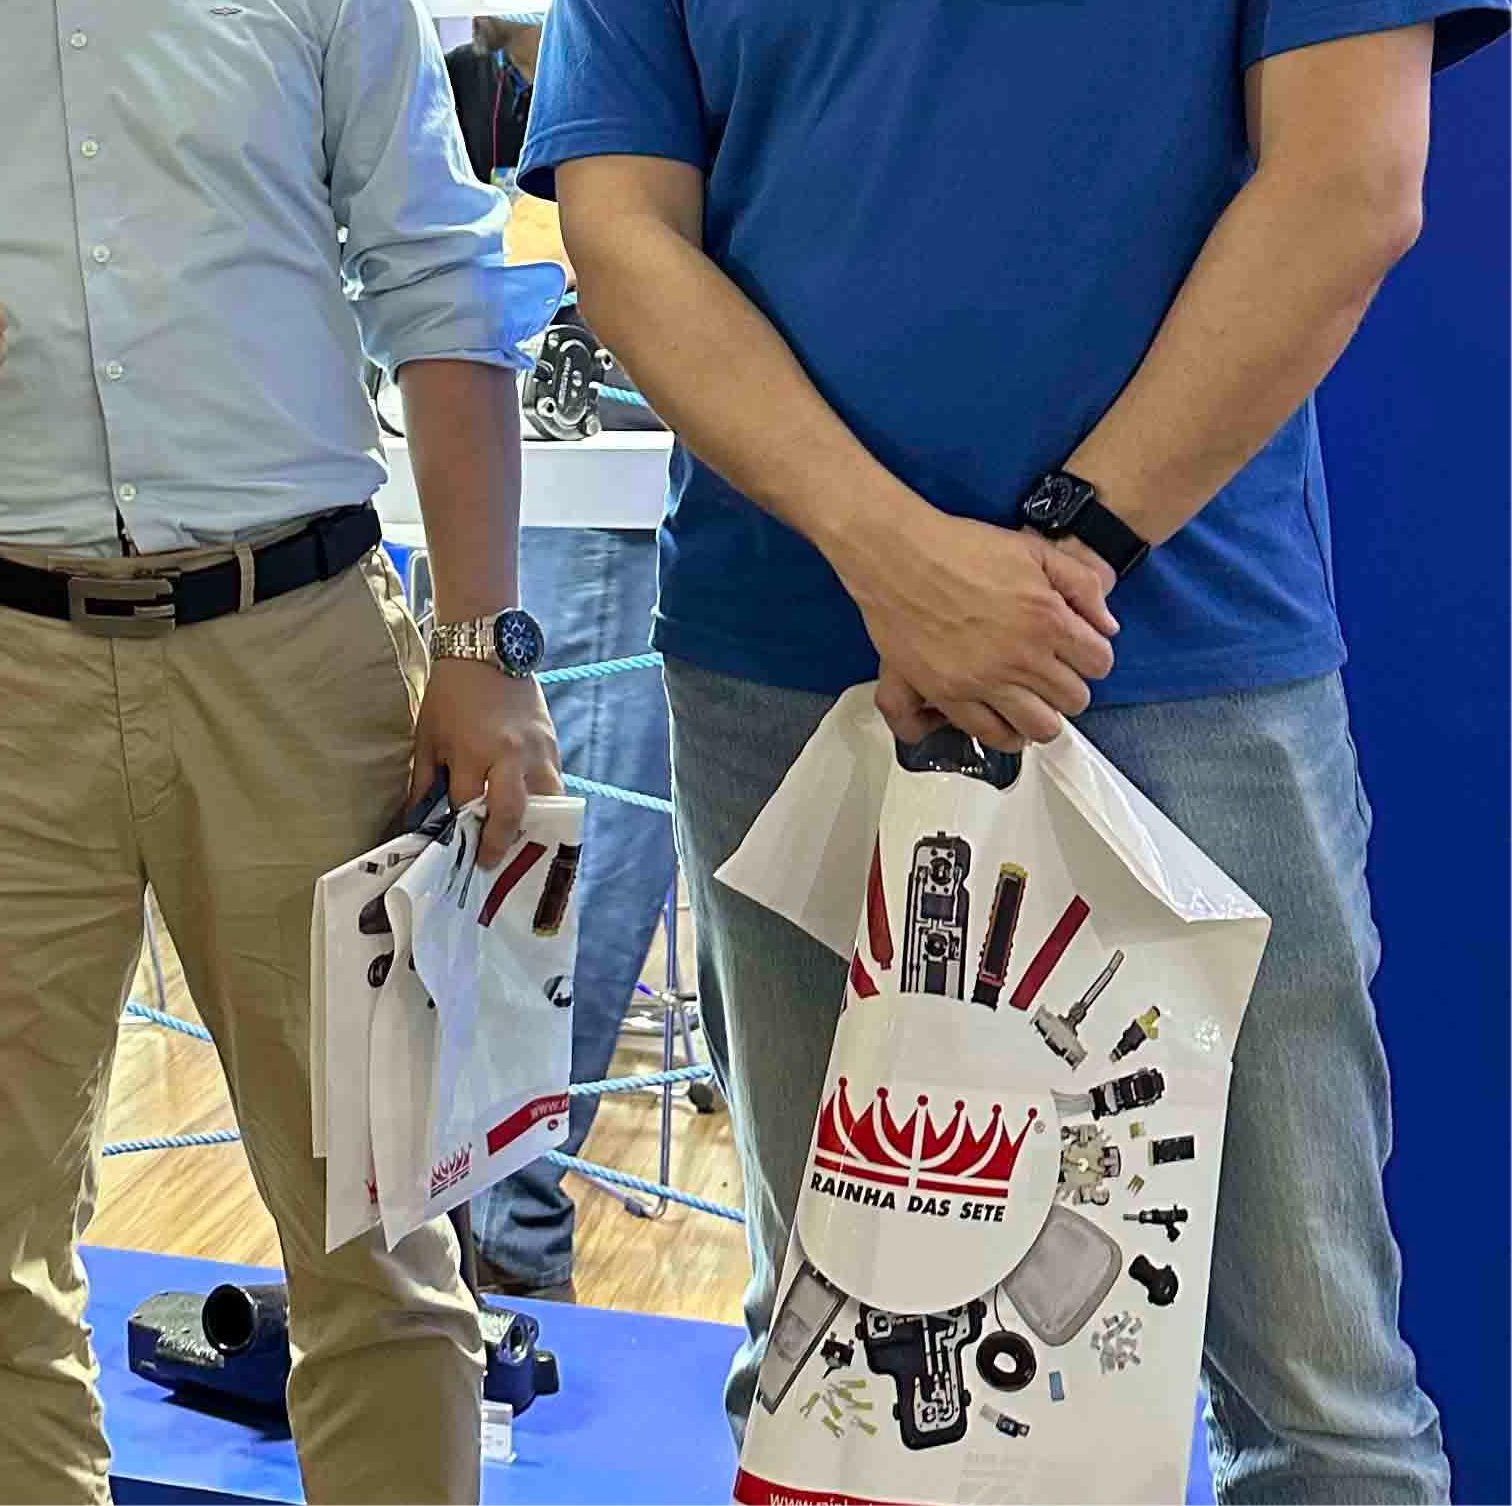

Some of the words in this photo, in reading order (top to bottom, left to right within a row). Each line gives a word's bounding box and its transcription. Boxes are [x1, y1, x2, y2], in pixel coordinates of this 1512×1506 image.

[810, 1171, 896, 1210] RAINHA
[906, 1195, 951, 1217] DAS
[959, 1200, 1006, 1223] SETE
